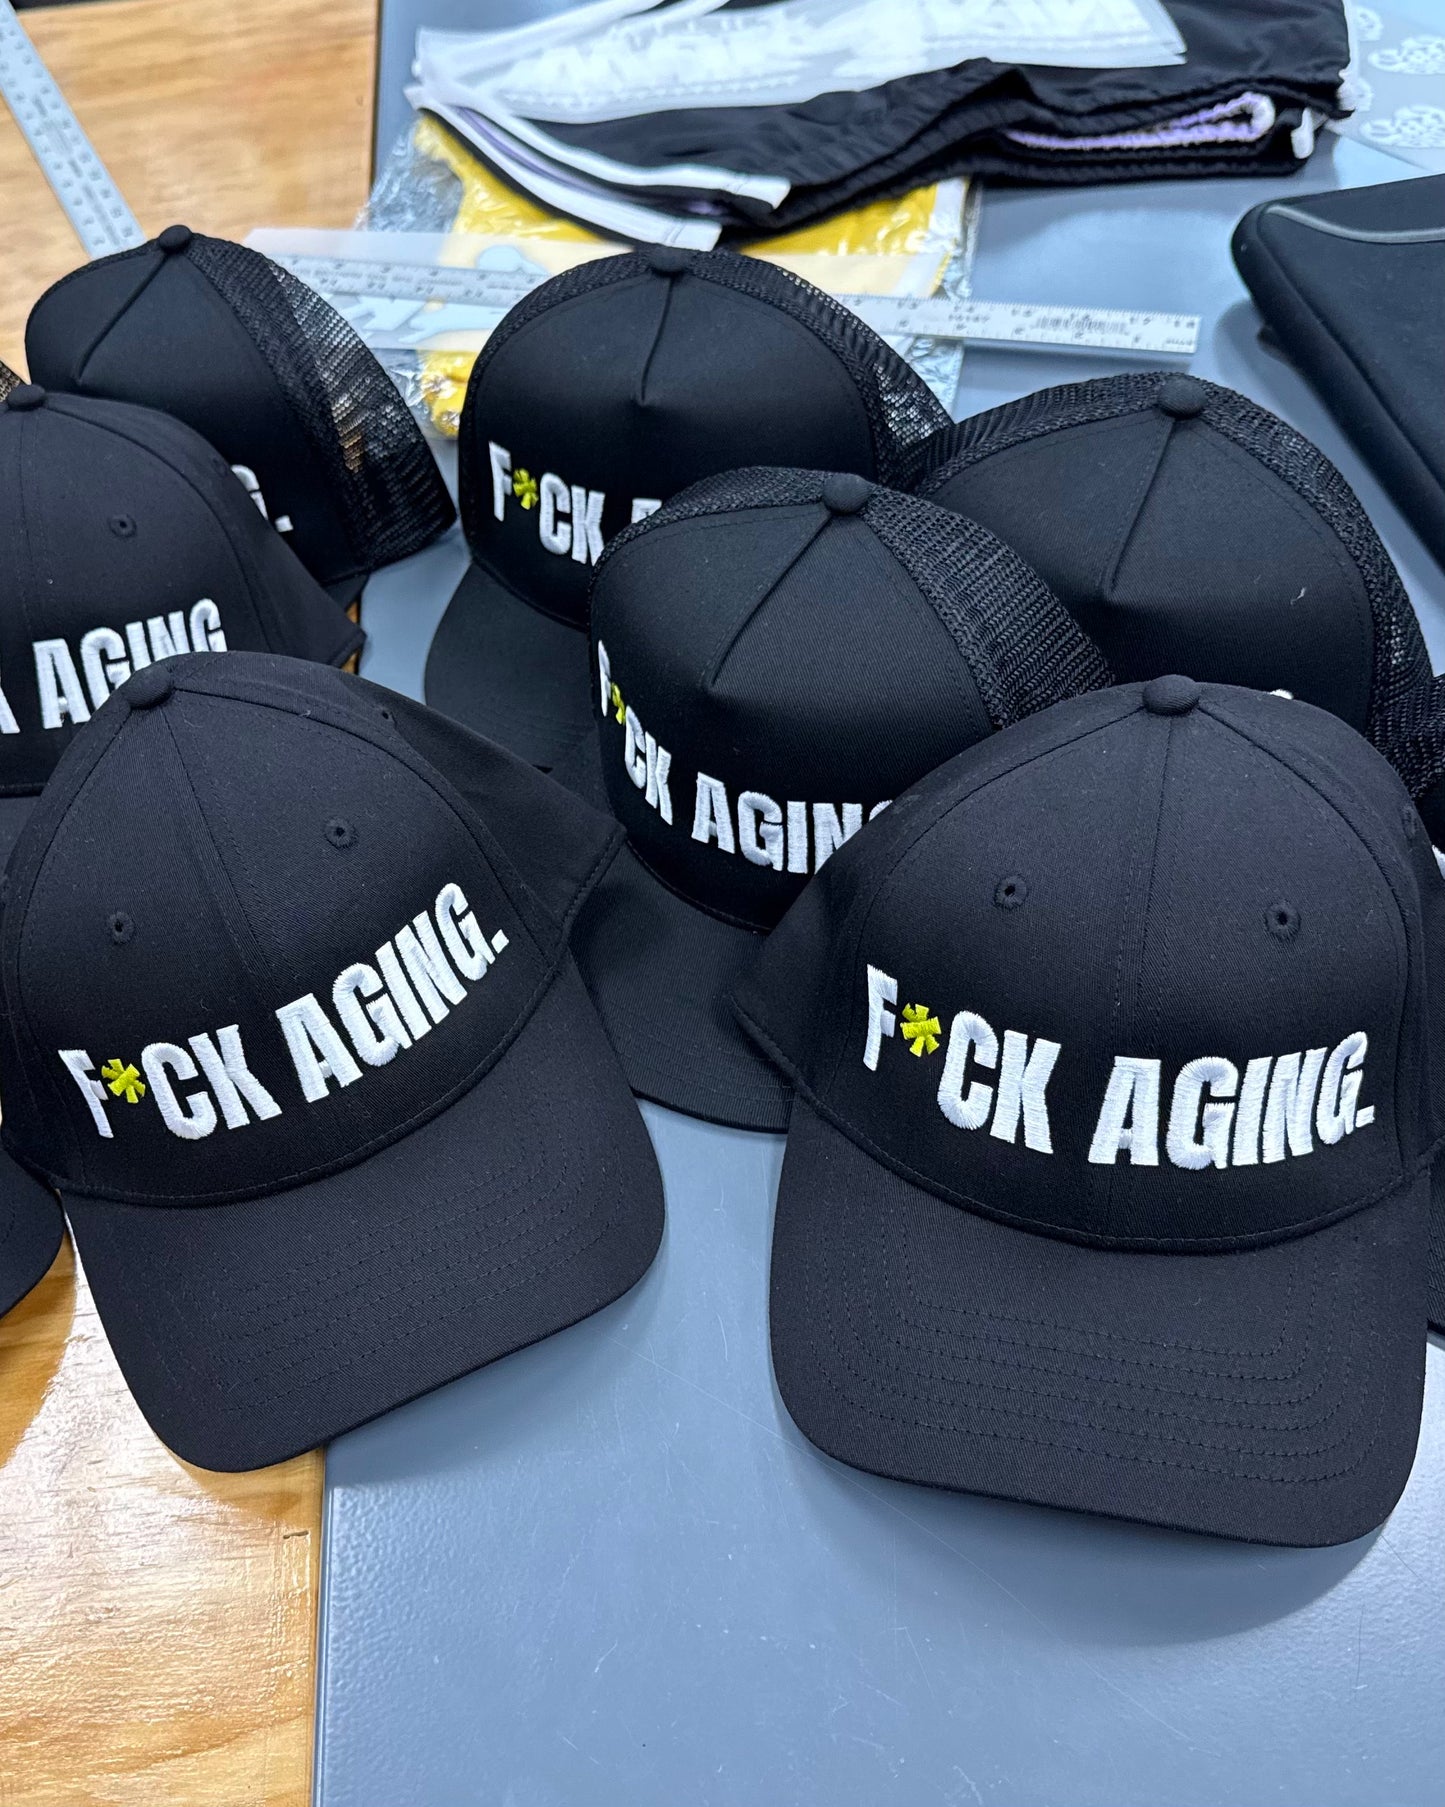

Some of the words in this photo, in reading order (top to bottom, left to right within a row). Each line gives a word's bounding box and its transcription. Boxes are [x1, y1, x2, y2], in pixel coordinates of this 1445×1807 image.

[691, 771, 893, 876] AGIN
[275, 882, 510, 1103] AGING.
[1088, 1031, 1375, 1171] AGING.
